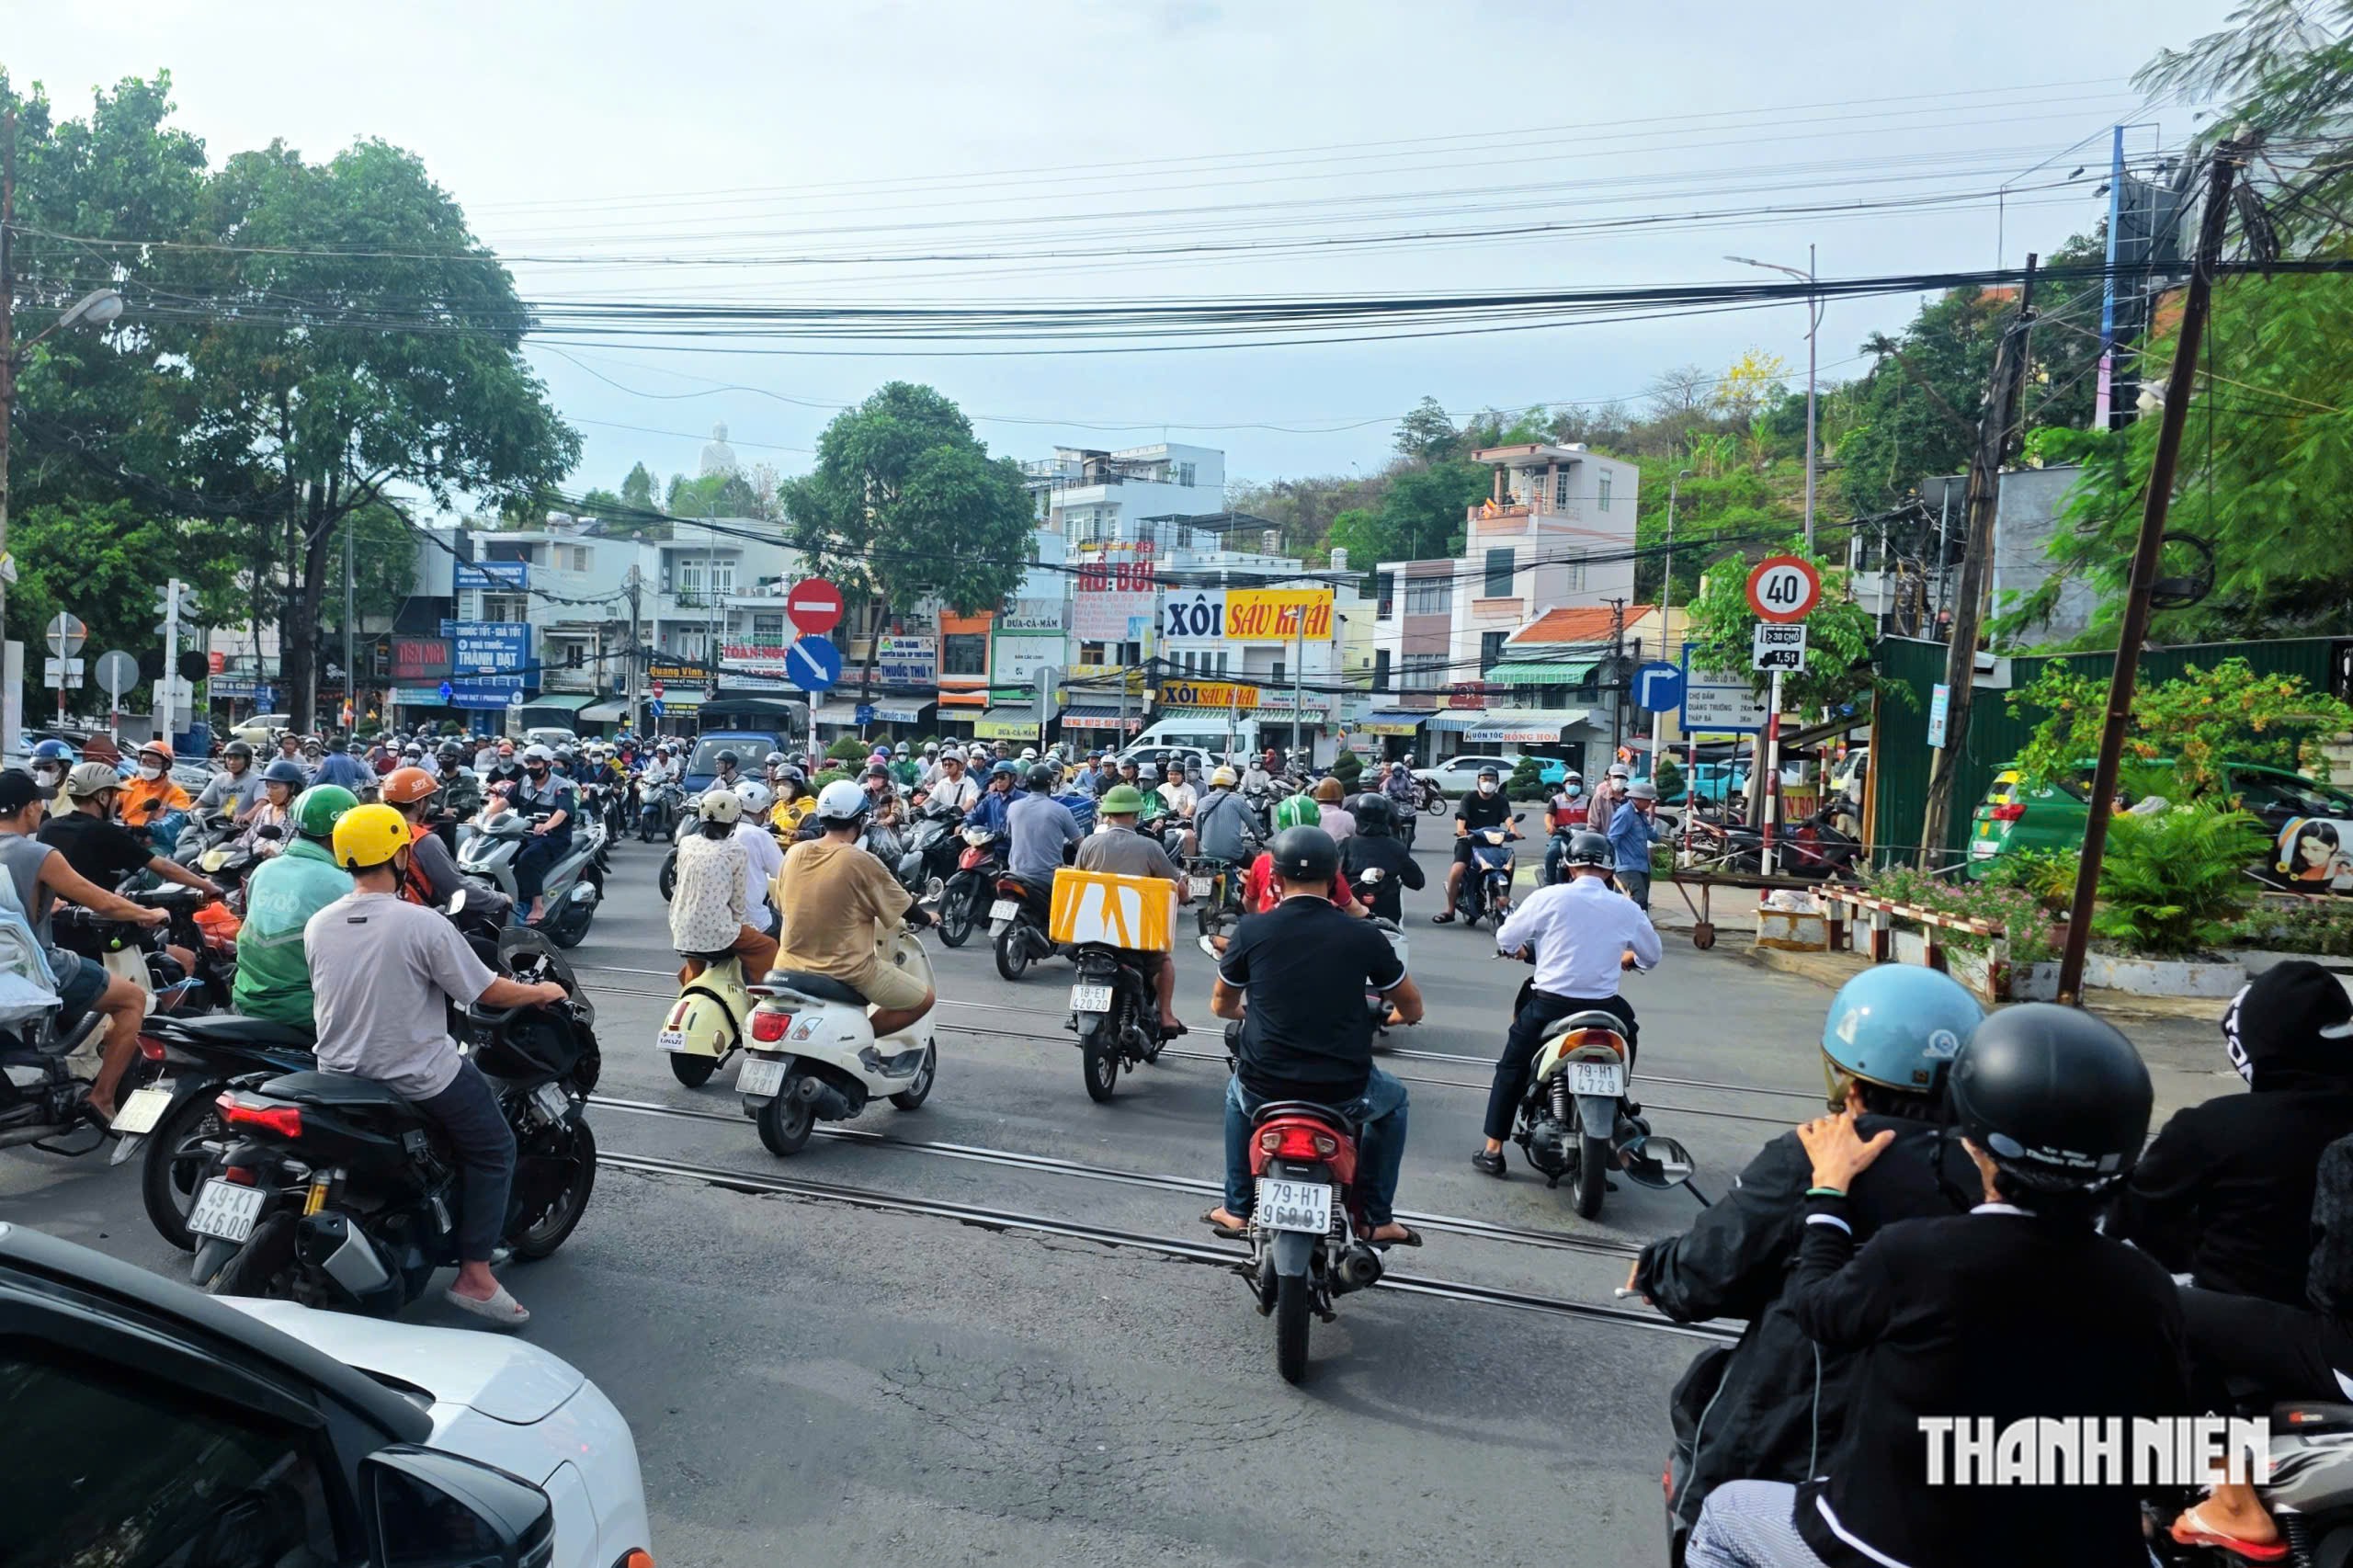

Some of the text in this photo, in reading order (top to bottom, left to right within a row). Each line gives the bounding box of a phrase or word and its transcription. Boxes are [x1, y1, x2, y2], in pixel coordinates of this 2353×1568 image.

[1767, 575, 1798, 604] 40
[1167, 593, 1222, 636] XÔI
[1228, 596, 1272, 635] SÁU
[458, 650, 494, 665] THÀNH
[1775, 653, 1796, 663] 1,5t
[649, 665, 703, 677] Quang Vinh
[881, 662, 908, 676] THUỐC
[927, 666, 933, 677] Y
[1164, 683, 1199, 703] XÔI
[256, 890, 301, 913] Grab
[208, 1185, 255, 1215] 49-K1
[1272, 1183, 1319, 1207] 79-H1
[191, 1207, 250, 1240] 946.00
